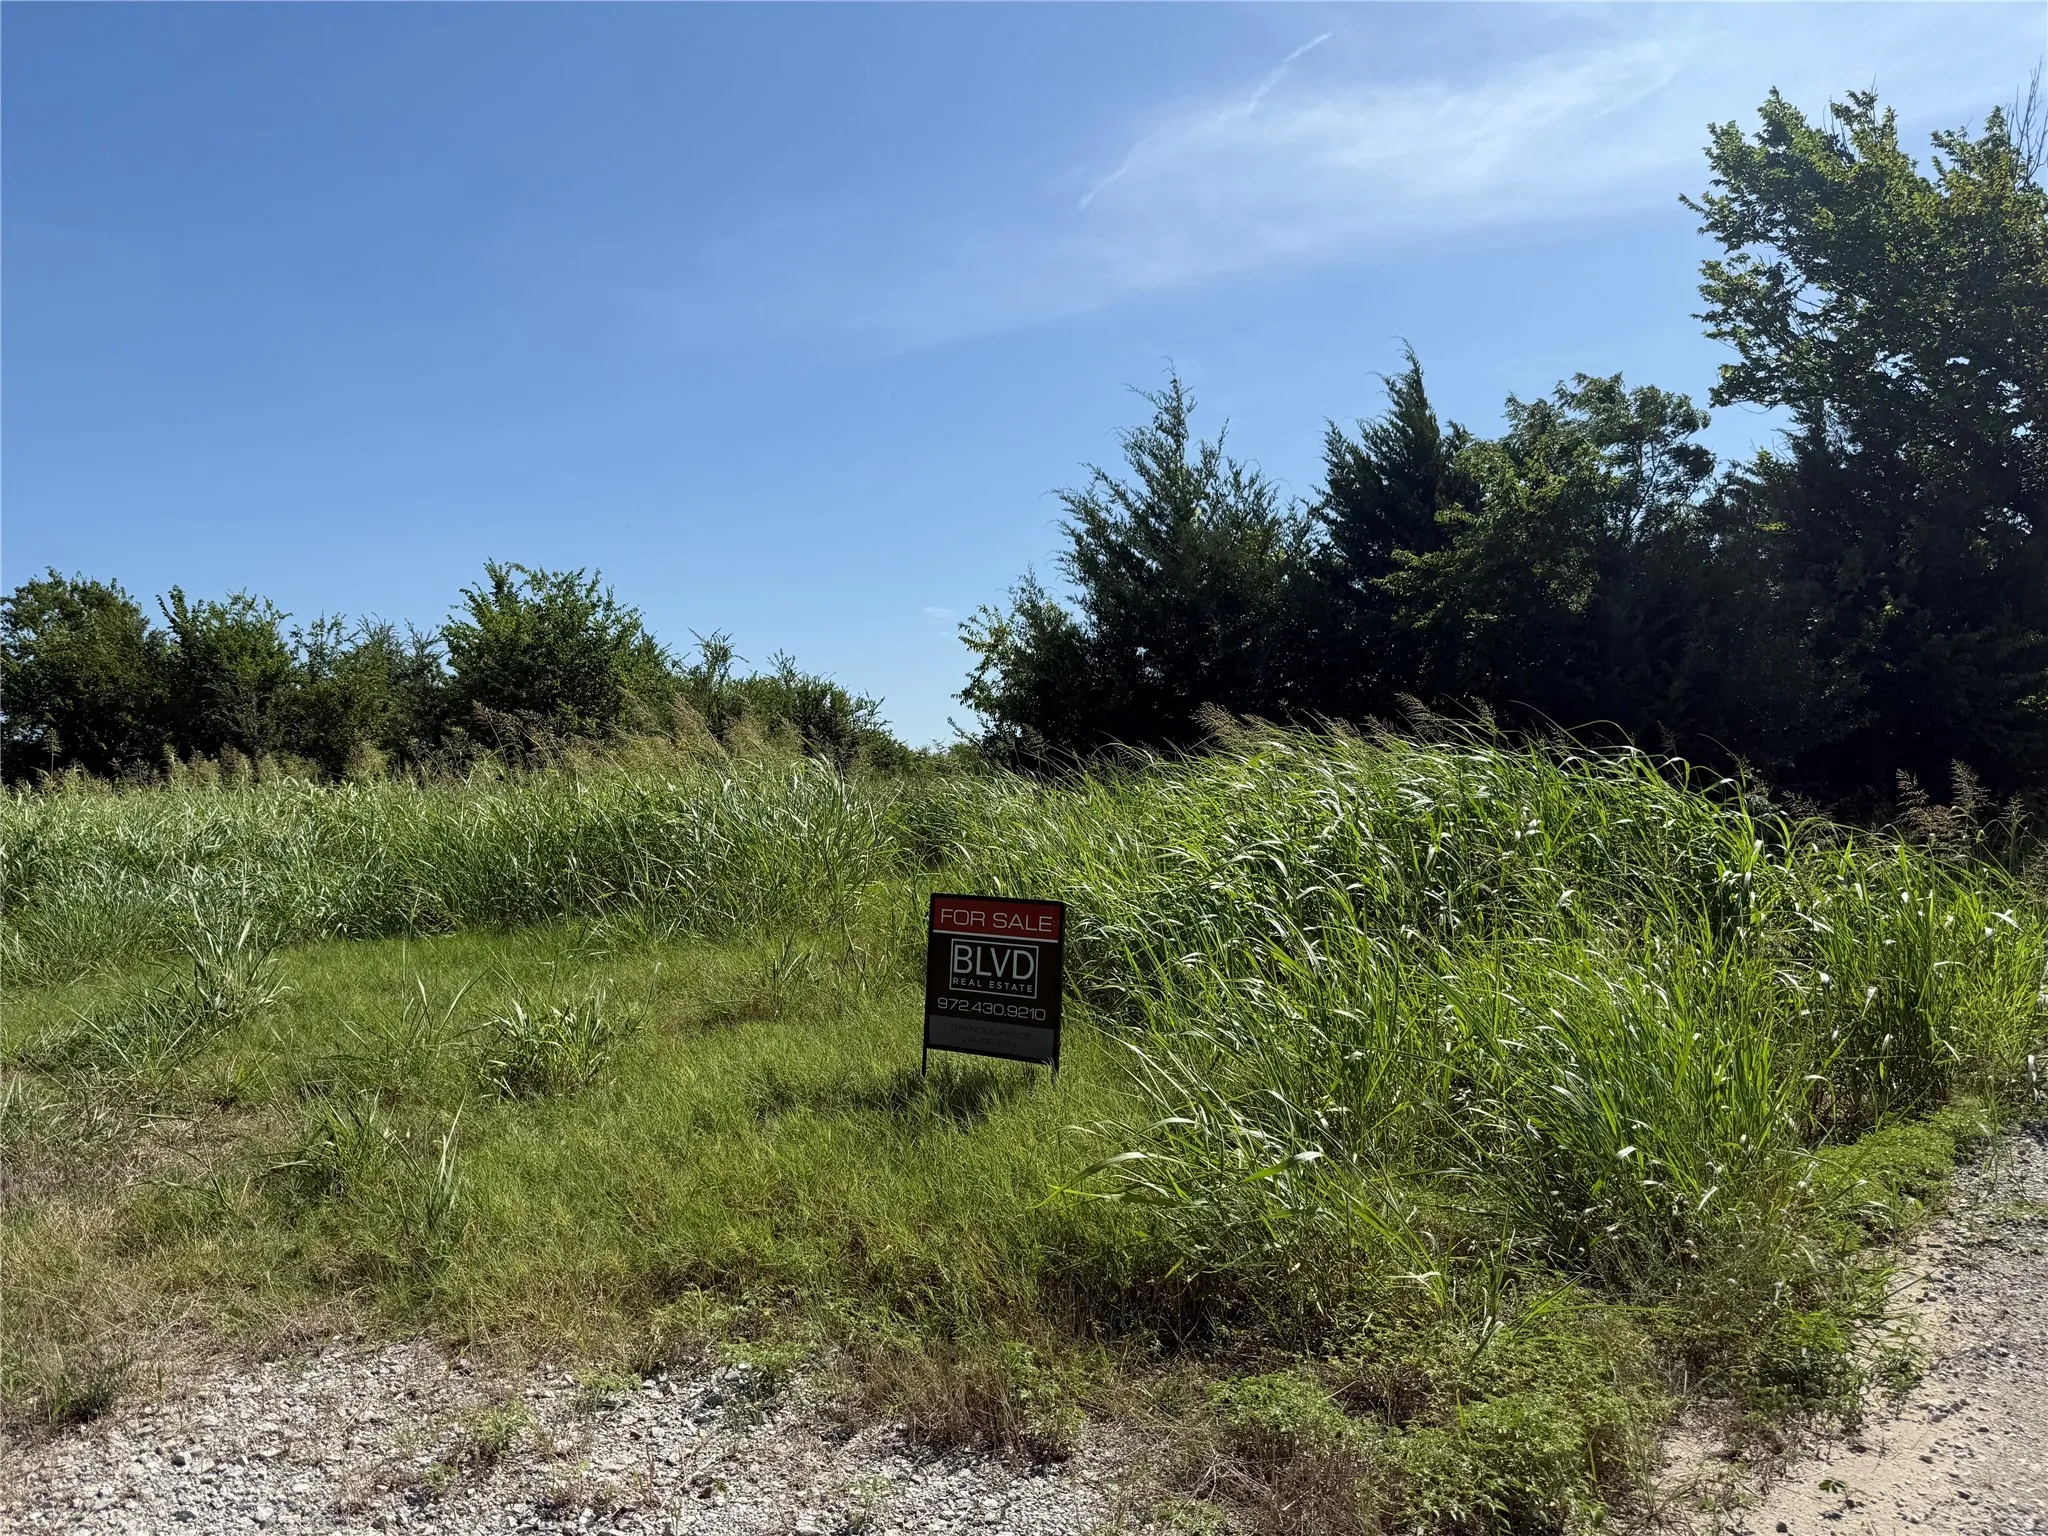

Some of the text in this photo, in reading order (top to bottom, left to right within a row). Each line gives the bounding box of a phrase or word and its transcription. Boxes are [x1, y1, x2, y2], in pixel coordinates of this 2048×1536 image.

[940, 908, 1053, 933] FOR SALE
[953, 944, 1034, 980] BLVD
[953, 977, 1033, 993] REAL ESTATE
[937, 997, 1046, 1021] 972.430.9210
